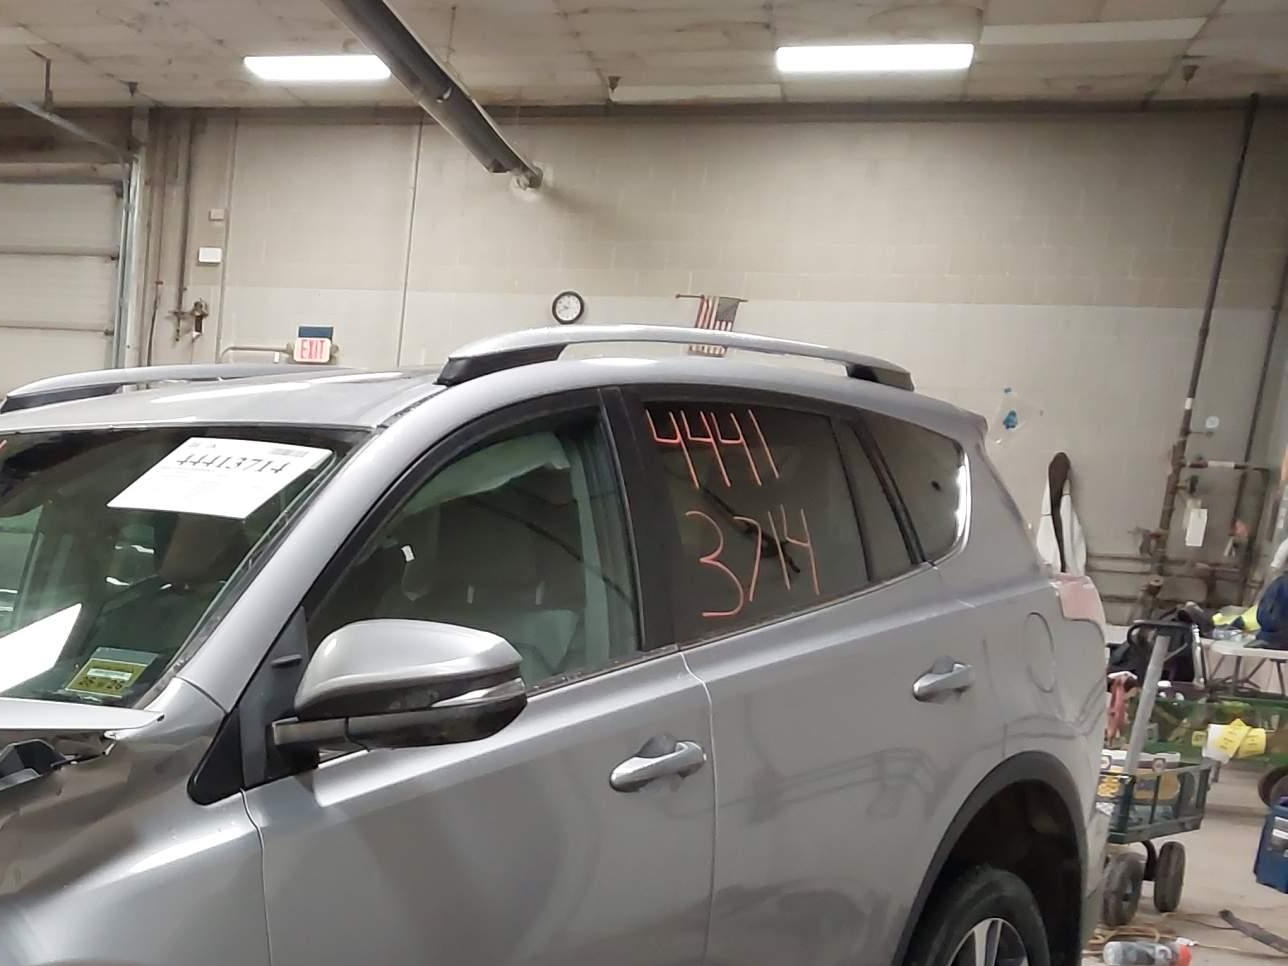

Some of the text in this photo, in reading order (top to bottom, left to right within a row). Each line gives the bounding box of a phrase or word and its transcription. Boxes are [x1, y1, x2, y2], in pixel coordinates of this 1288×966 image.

[300, 338, 326, 360] EXIT
[176, 453, 291, 474] 44413714
[644, 408, 780, 489] 4441
[684, 504, 821, 618] 3714
